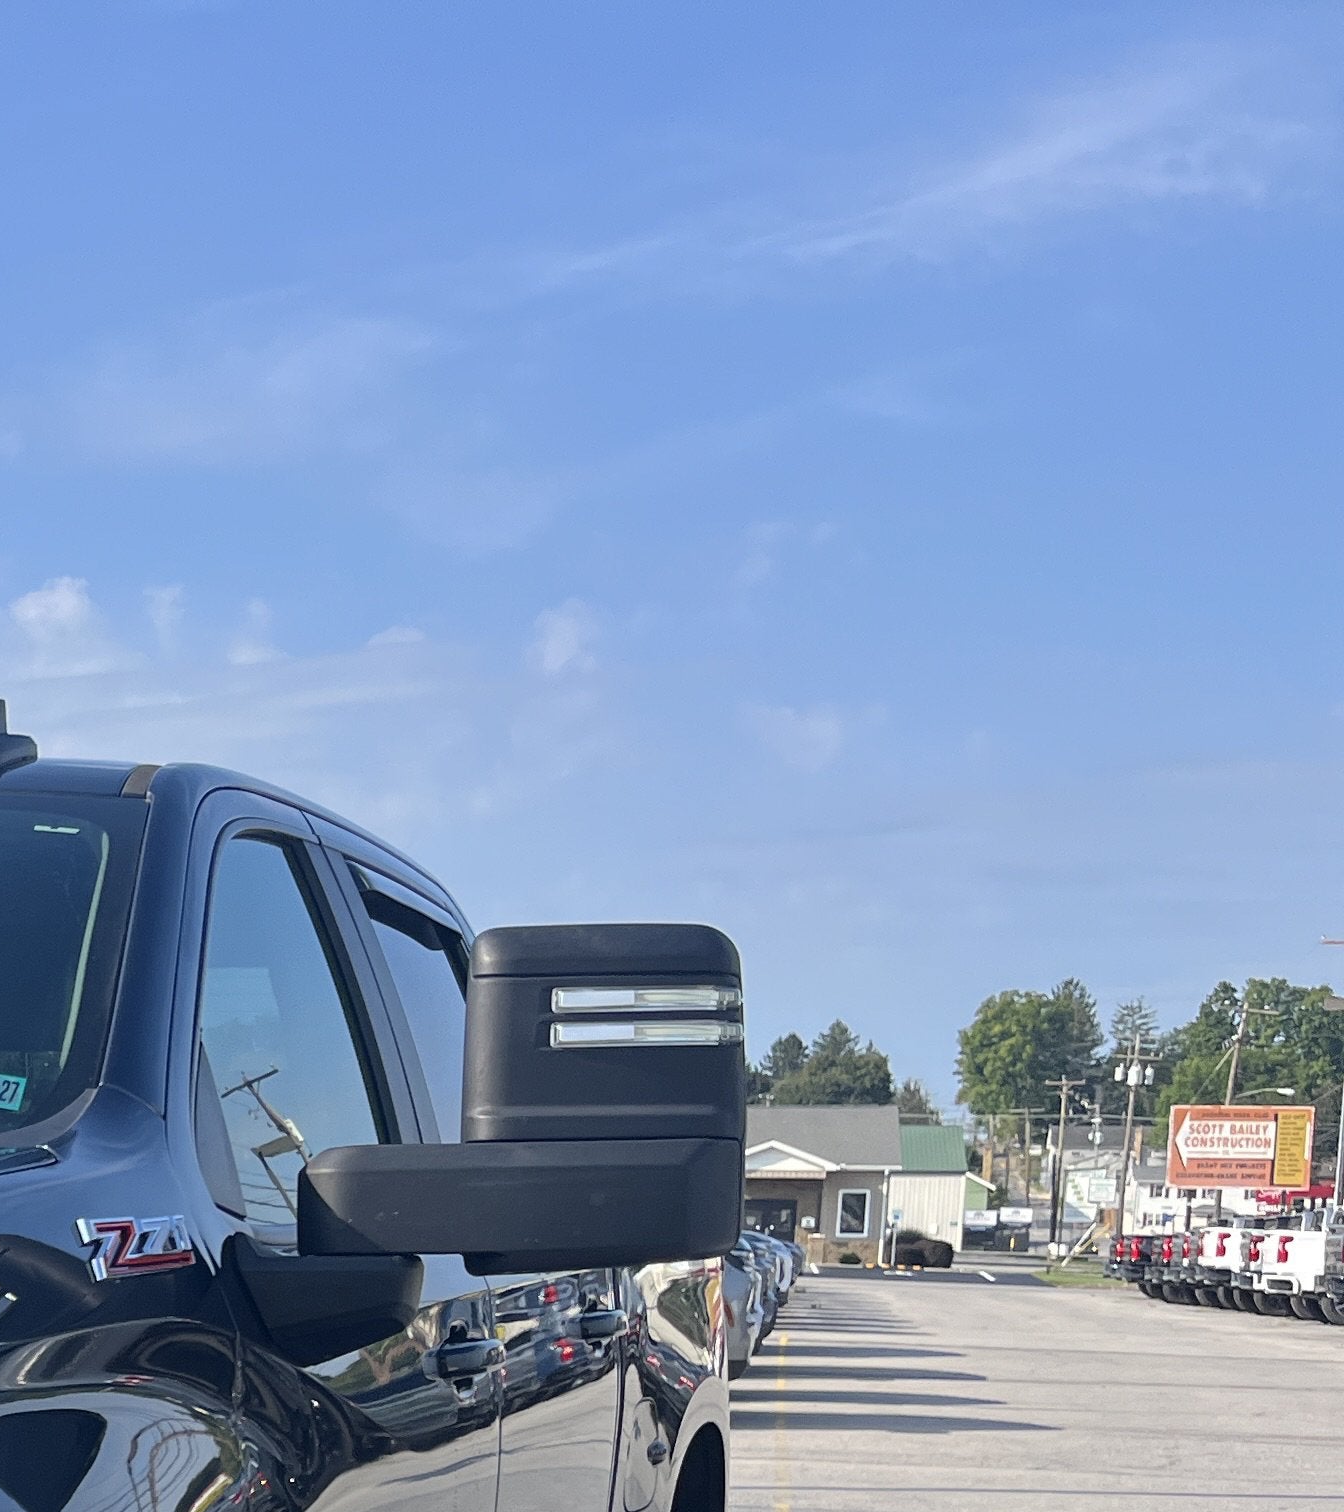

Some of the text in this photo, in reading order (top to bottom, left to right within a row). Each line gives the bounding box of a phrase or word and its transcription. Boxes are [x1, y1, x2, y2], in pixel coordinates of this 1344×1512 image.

[1188, 1123, 1269, 1135] SCOTT BAILEY
[1184, 1137, 1272, 1149] CONSTRUCTION
[76, 1215, 197, 1281] Z71
